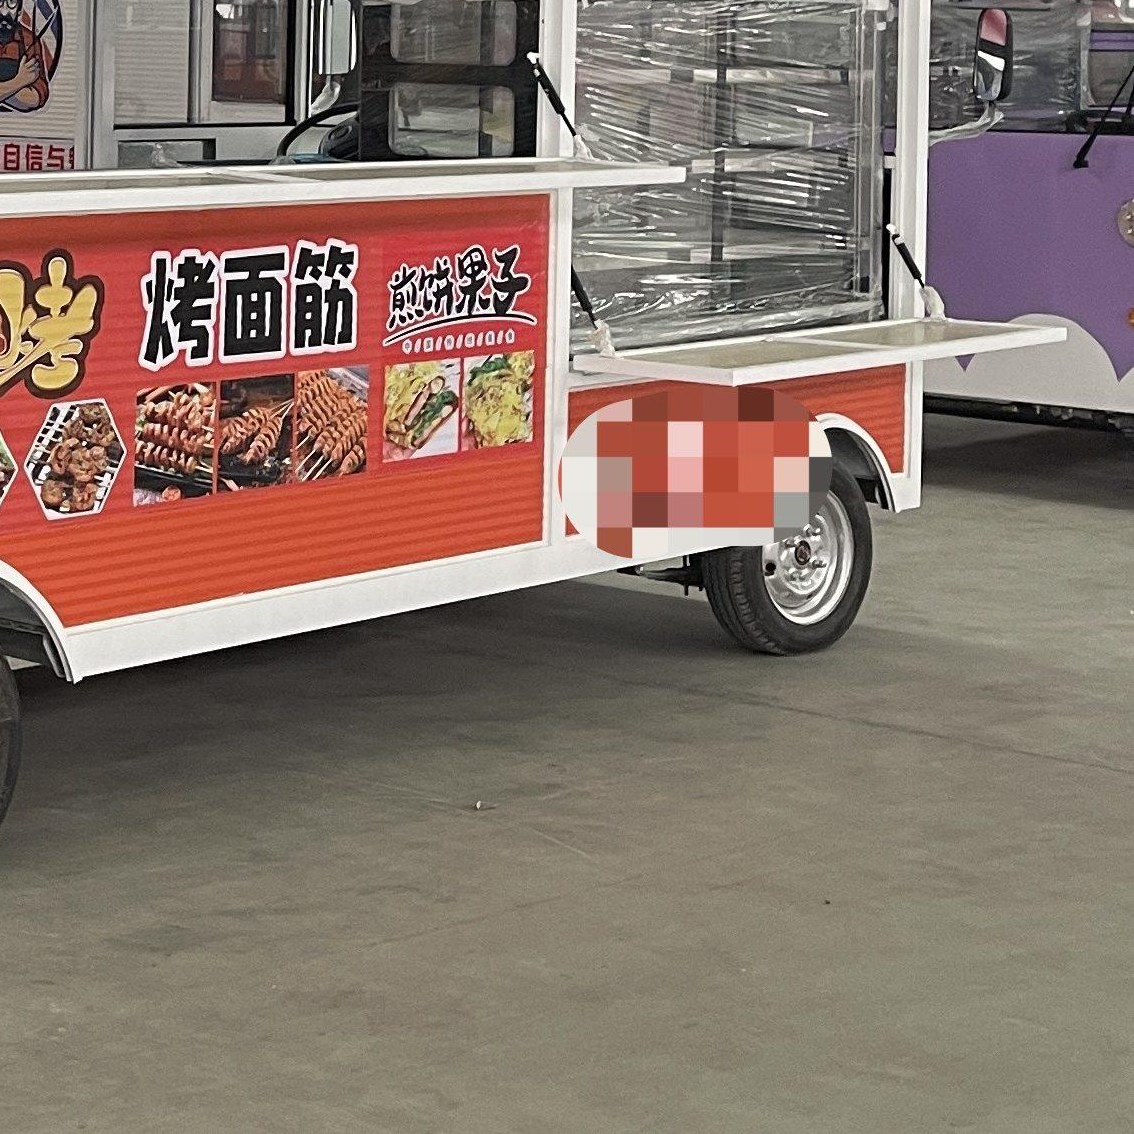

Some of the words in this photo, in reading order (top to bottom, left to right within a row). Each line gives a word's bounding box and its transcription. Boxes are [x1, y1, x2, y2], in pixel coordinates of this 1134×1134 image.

[141, 240, 358, 367] 烤面筋
[388, 246, 530, 330] 煎饼果子
